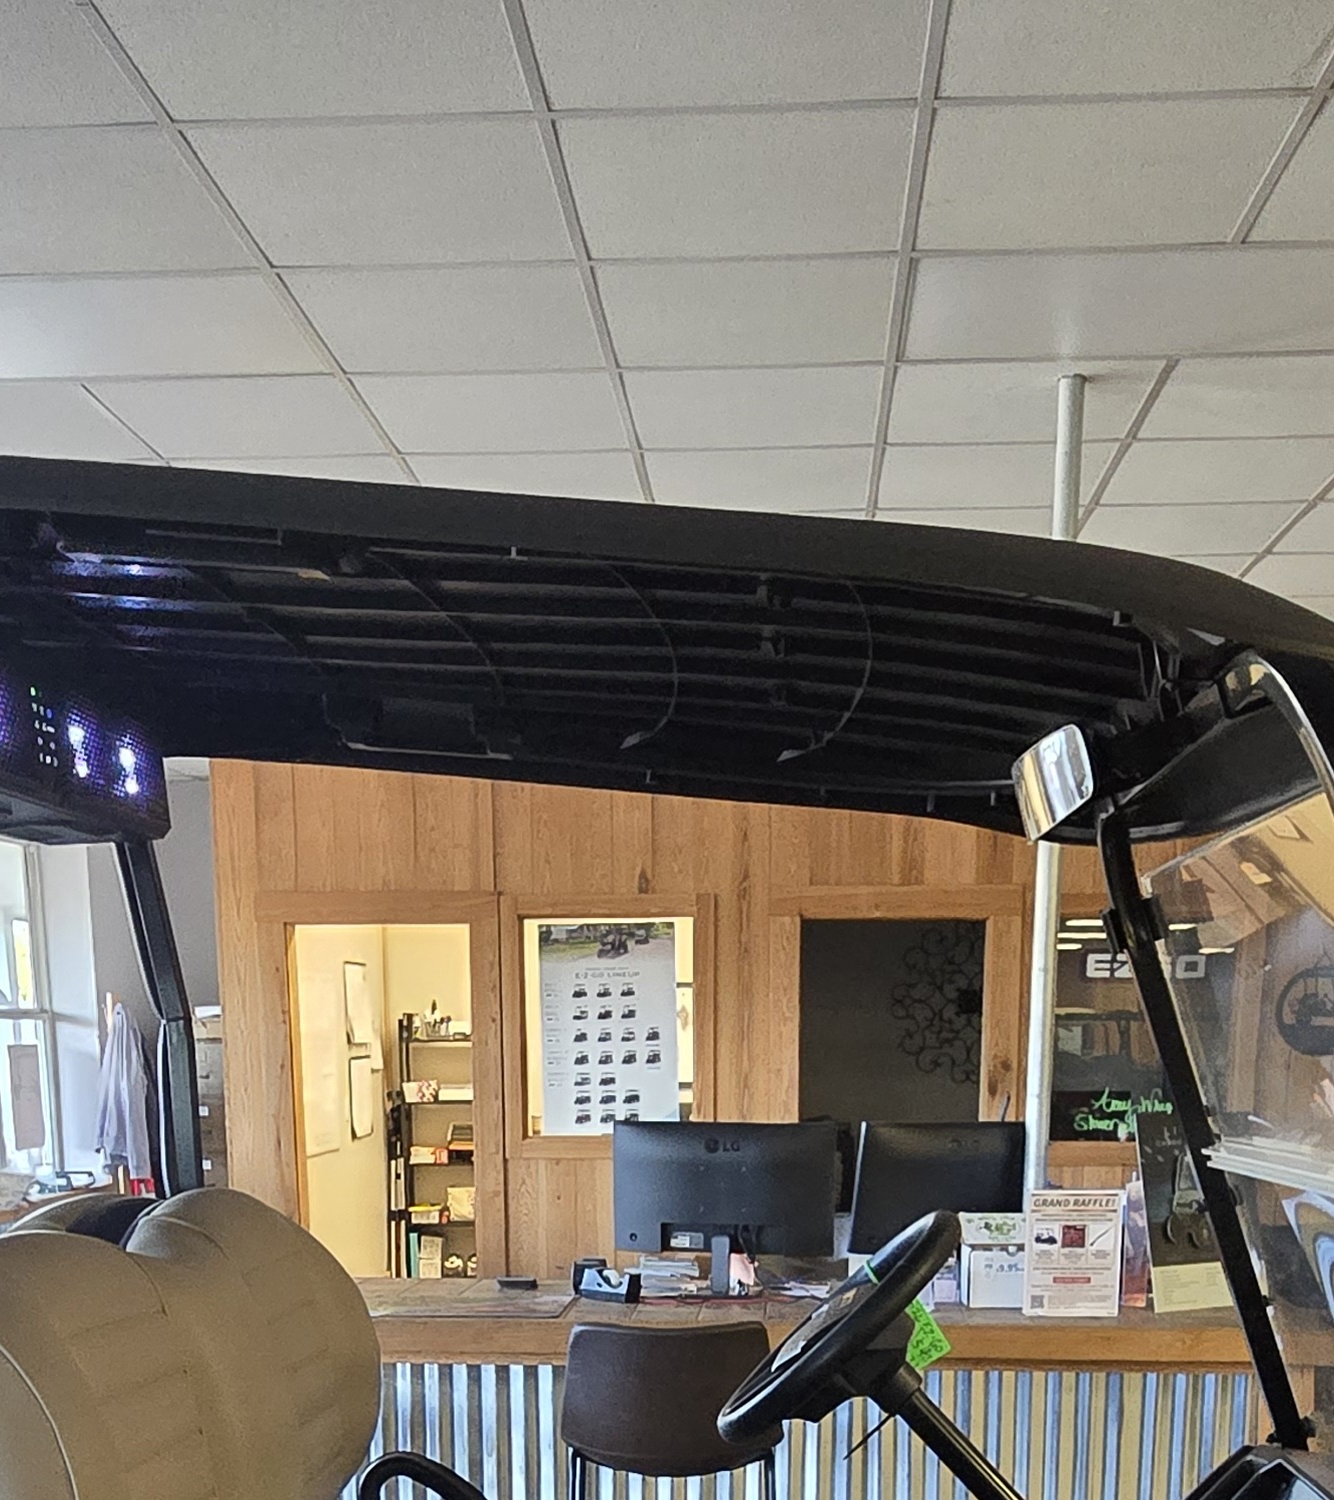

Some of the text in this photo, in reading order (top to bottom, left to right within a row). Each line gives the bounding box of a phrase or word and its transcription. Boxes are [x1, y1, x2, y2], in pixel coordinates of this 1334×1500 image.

[1085, 953, 1207, 979] EZO
[721, 1139, 741, 1152] LG
[1033, 1197, 1117, 1208] GRAND RAFFLE!
